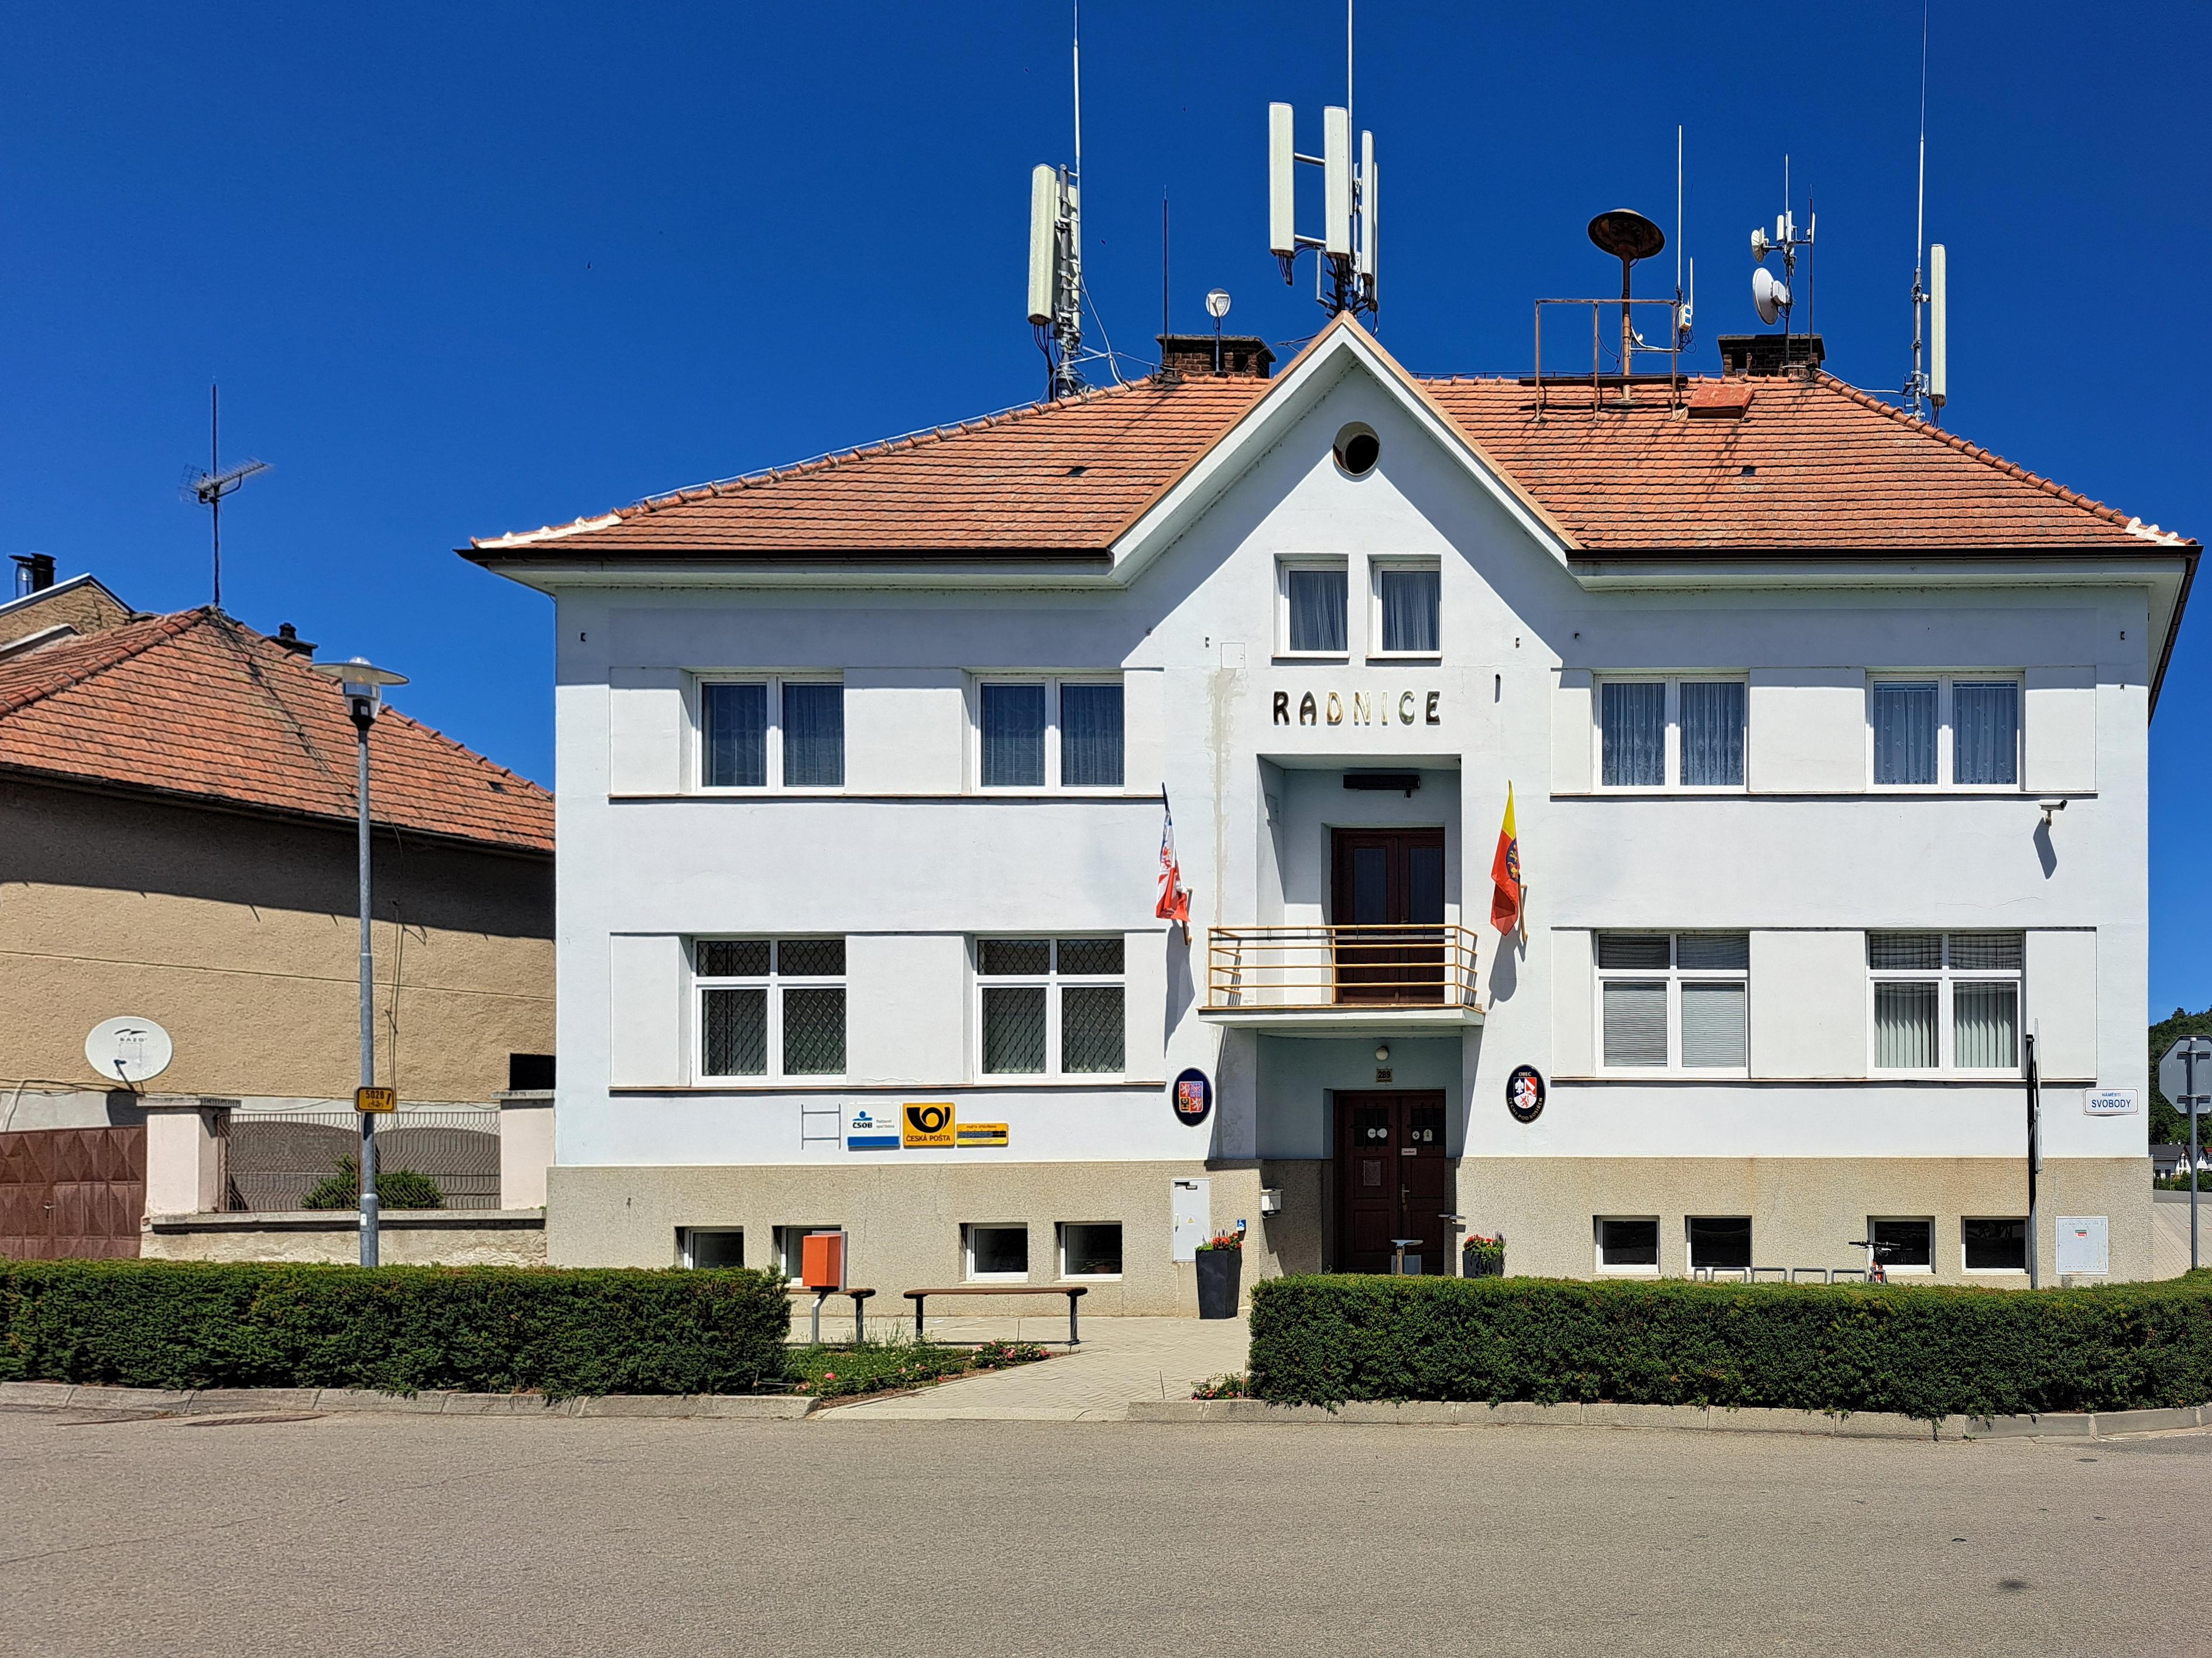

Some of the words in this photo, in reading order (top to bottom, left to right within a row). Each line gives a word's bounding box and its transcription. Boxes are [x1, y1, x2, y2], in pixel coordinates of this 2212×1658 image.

[1273, 691, 1441, 726] RADNICE
[365, 1090, 385, 1099] 5028
[2091, 1099, 2131, 1108] SVOBODY
[906, 1134, 927, 1142] ČESKÁ
